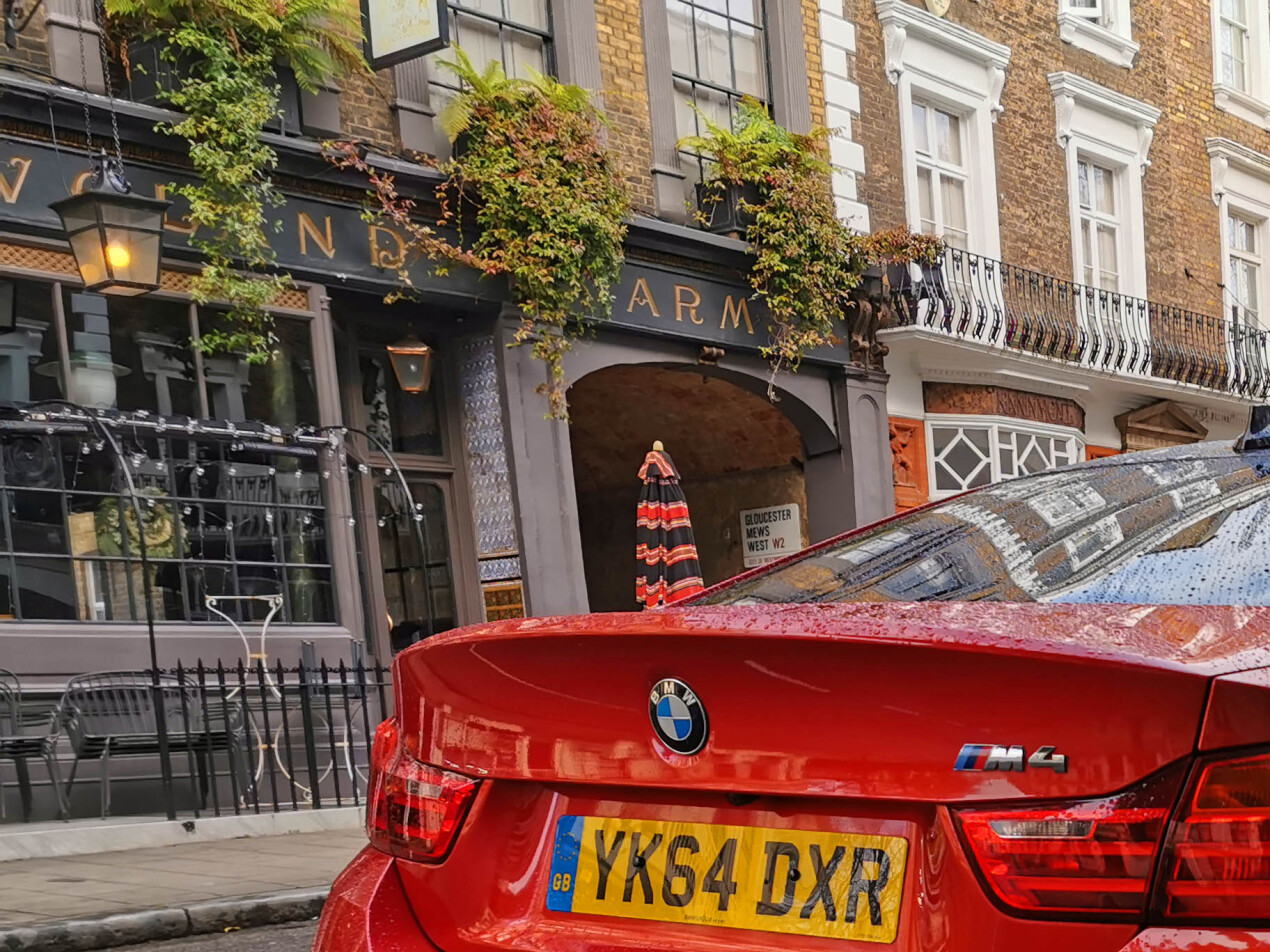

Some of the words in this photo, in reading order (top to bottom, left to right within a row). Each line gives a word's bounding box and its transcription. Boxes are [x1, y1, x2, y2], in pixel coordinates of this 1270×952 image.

[744, 508, 792, 526] GLOUCESTER
[746, 525, 770, 540] MEWS
[747, 539, 769, 552] WEST
[772, 536, 785, 550] W2
[650, 680, 697, 707] BMW
[976, 743, 1067, 774] M4
[552, 872, 572, 892] GB
[594, 829, 738, 912] YK64
[755, 840, 891, 927] DXR
